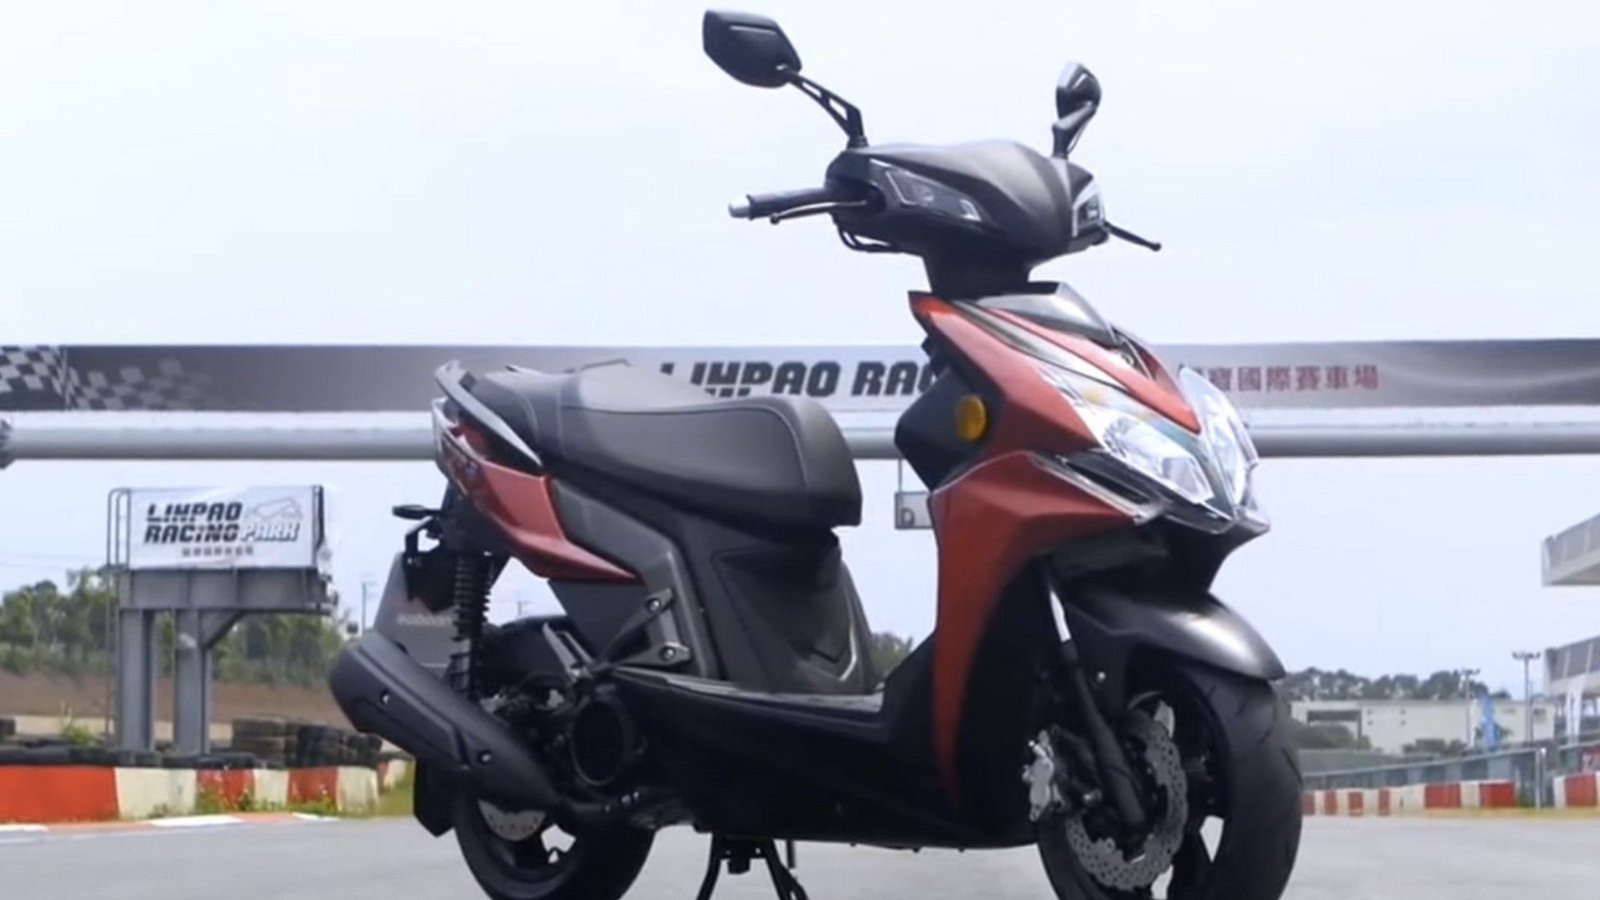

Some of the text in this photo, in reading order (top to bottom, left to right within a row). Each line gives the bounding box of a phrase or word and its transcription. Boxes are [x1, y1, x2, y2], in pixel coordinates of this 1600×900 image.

[660, 361, 841, 397] IHPAO
[1177, 364, 1379, 392] 寶國際賽車場
[146, 502, 243, 523] LIHPAO
[144, 521, 300, 544] RACING PARK
